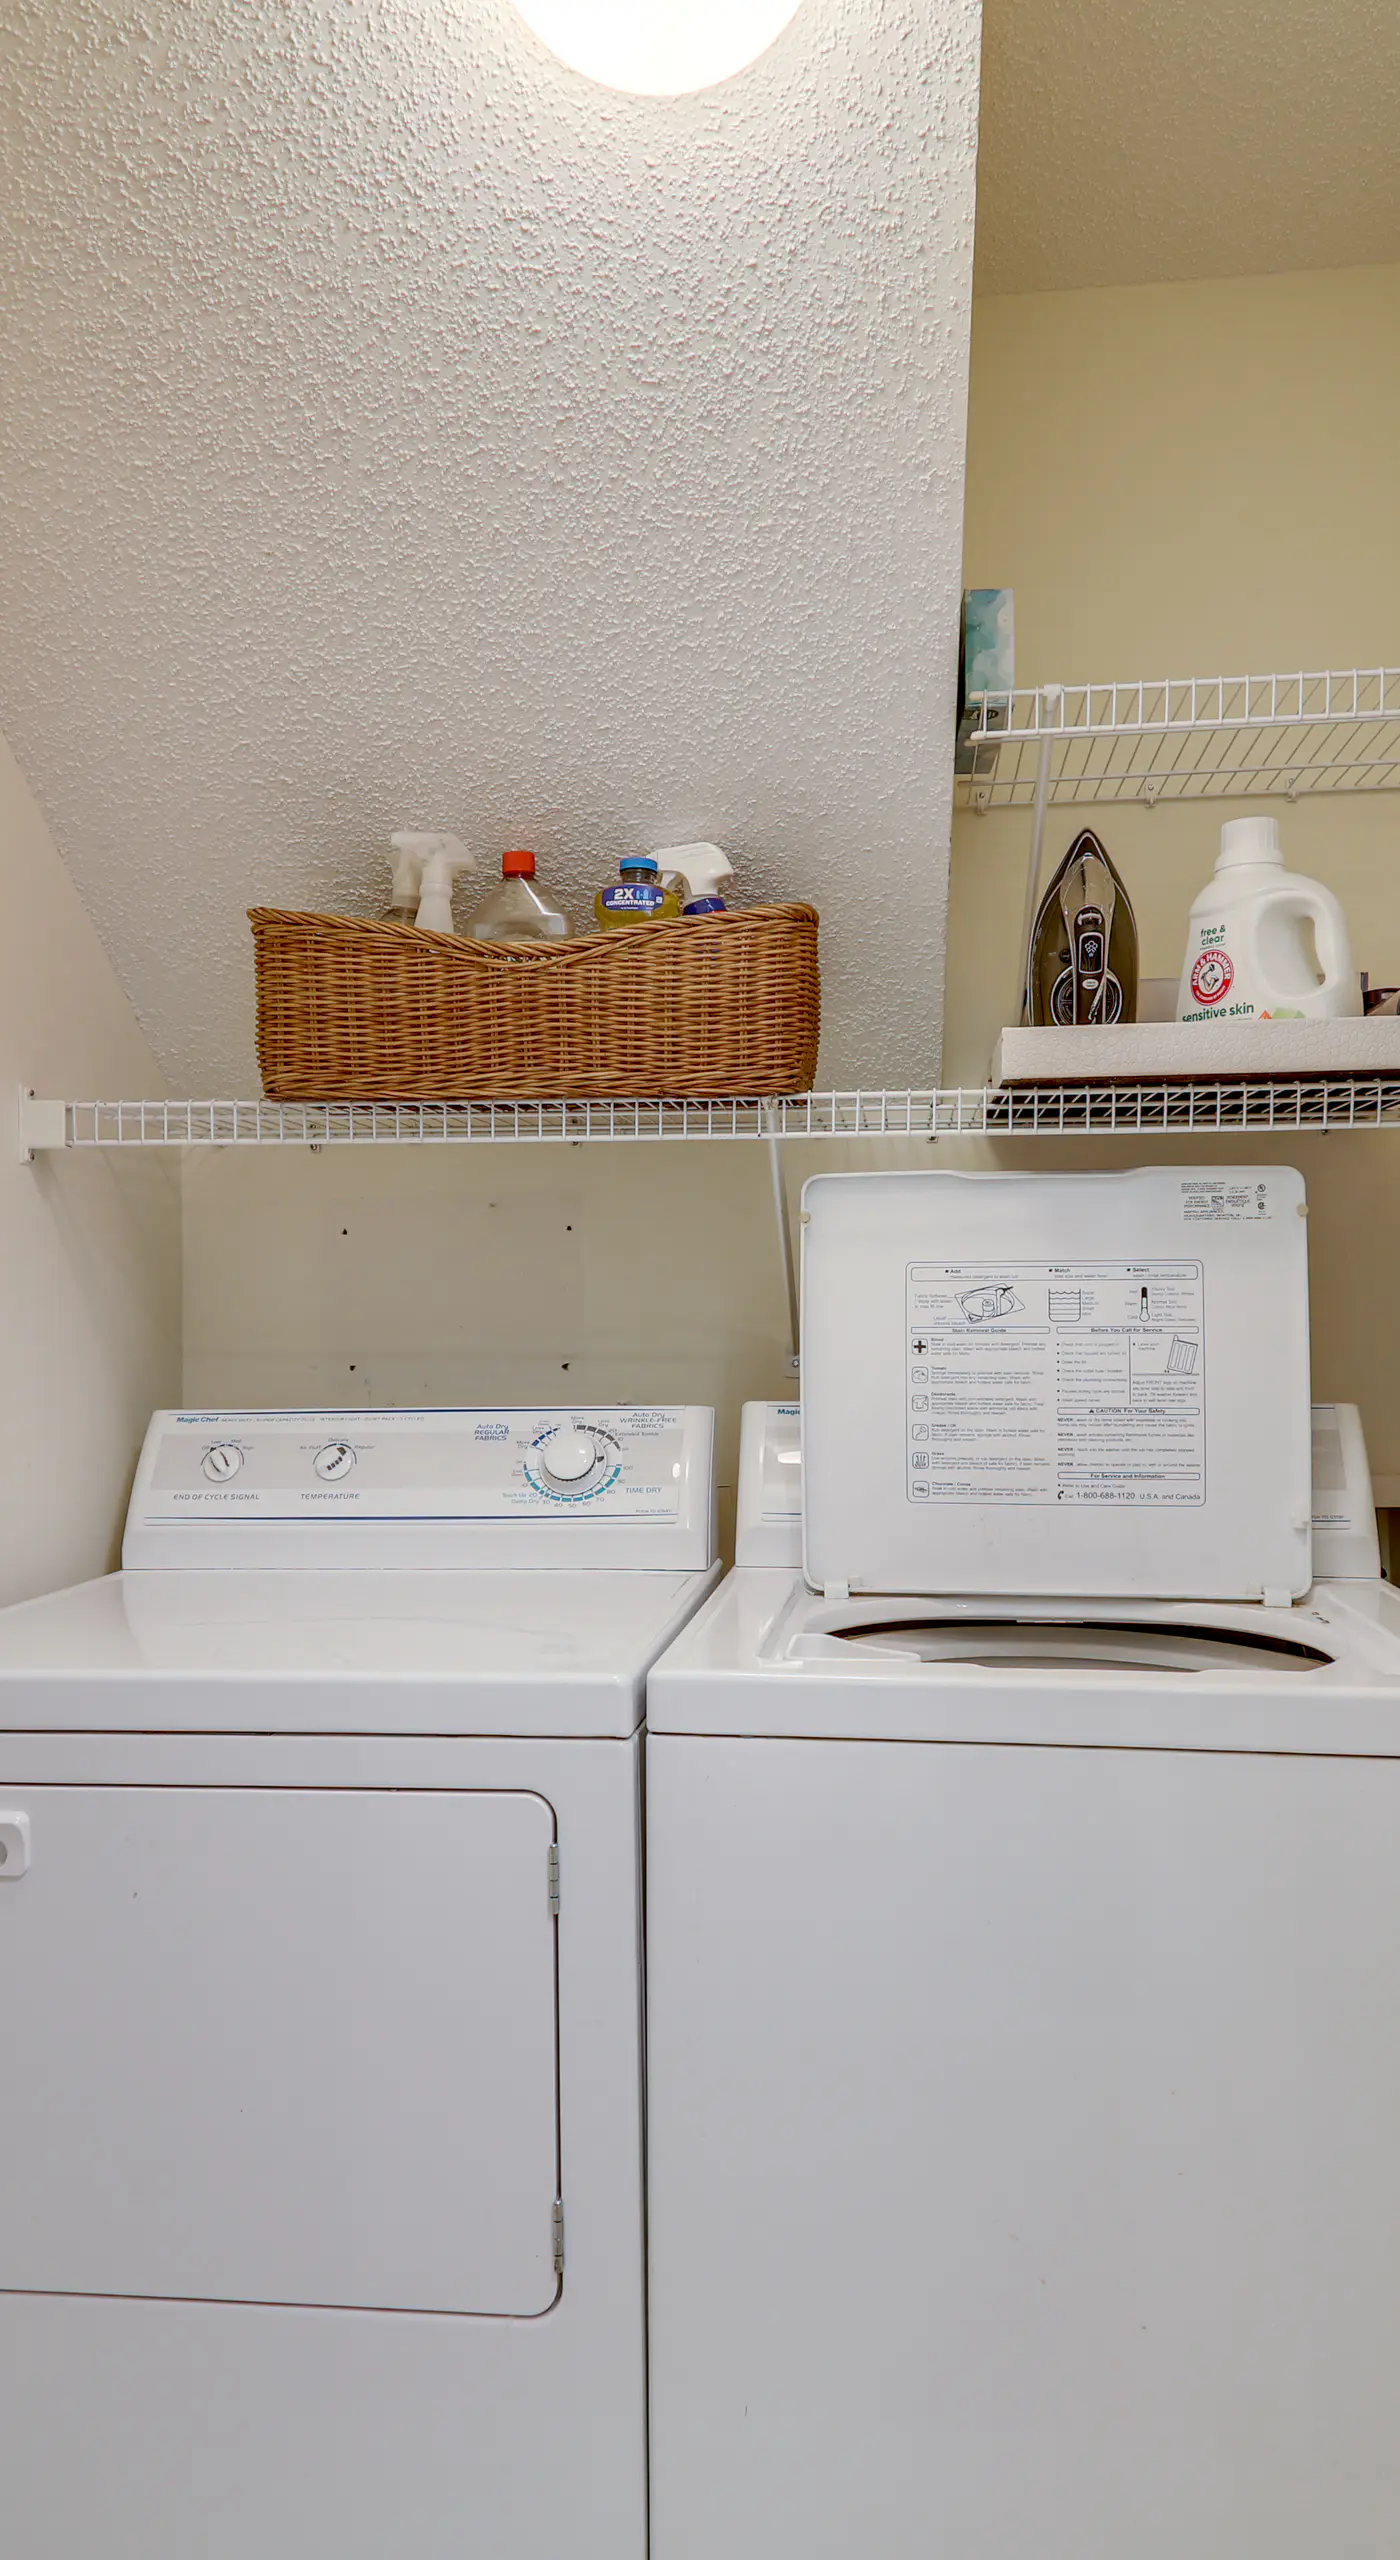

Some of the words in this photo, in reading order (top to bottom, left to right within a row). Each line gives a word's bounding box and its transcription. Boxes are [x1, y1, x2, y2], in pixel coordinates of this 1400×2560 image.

[614, 888, 634, 900] 2X
[1200, 927, 1218, 938] free
[1219, 924, 1227, 934] &
[1201, 934, 1225, 946] clear
[1192, 960, 1202, 986] ARM
[1206, 952, 1232, 981] HAMMER
[1182, 1006, 1228, 1022] sensitive
[1229, 1002, 1255, 1017] skin
[778, 1408, 800, 1416] Magic
[1077, 1492, 1136, 1500] 1-800-688-1120
